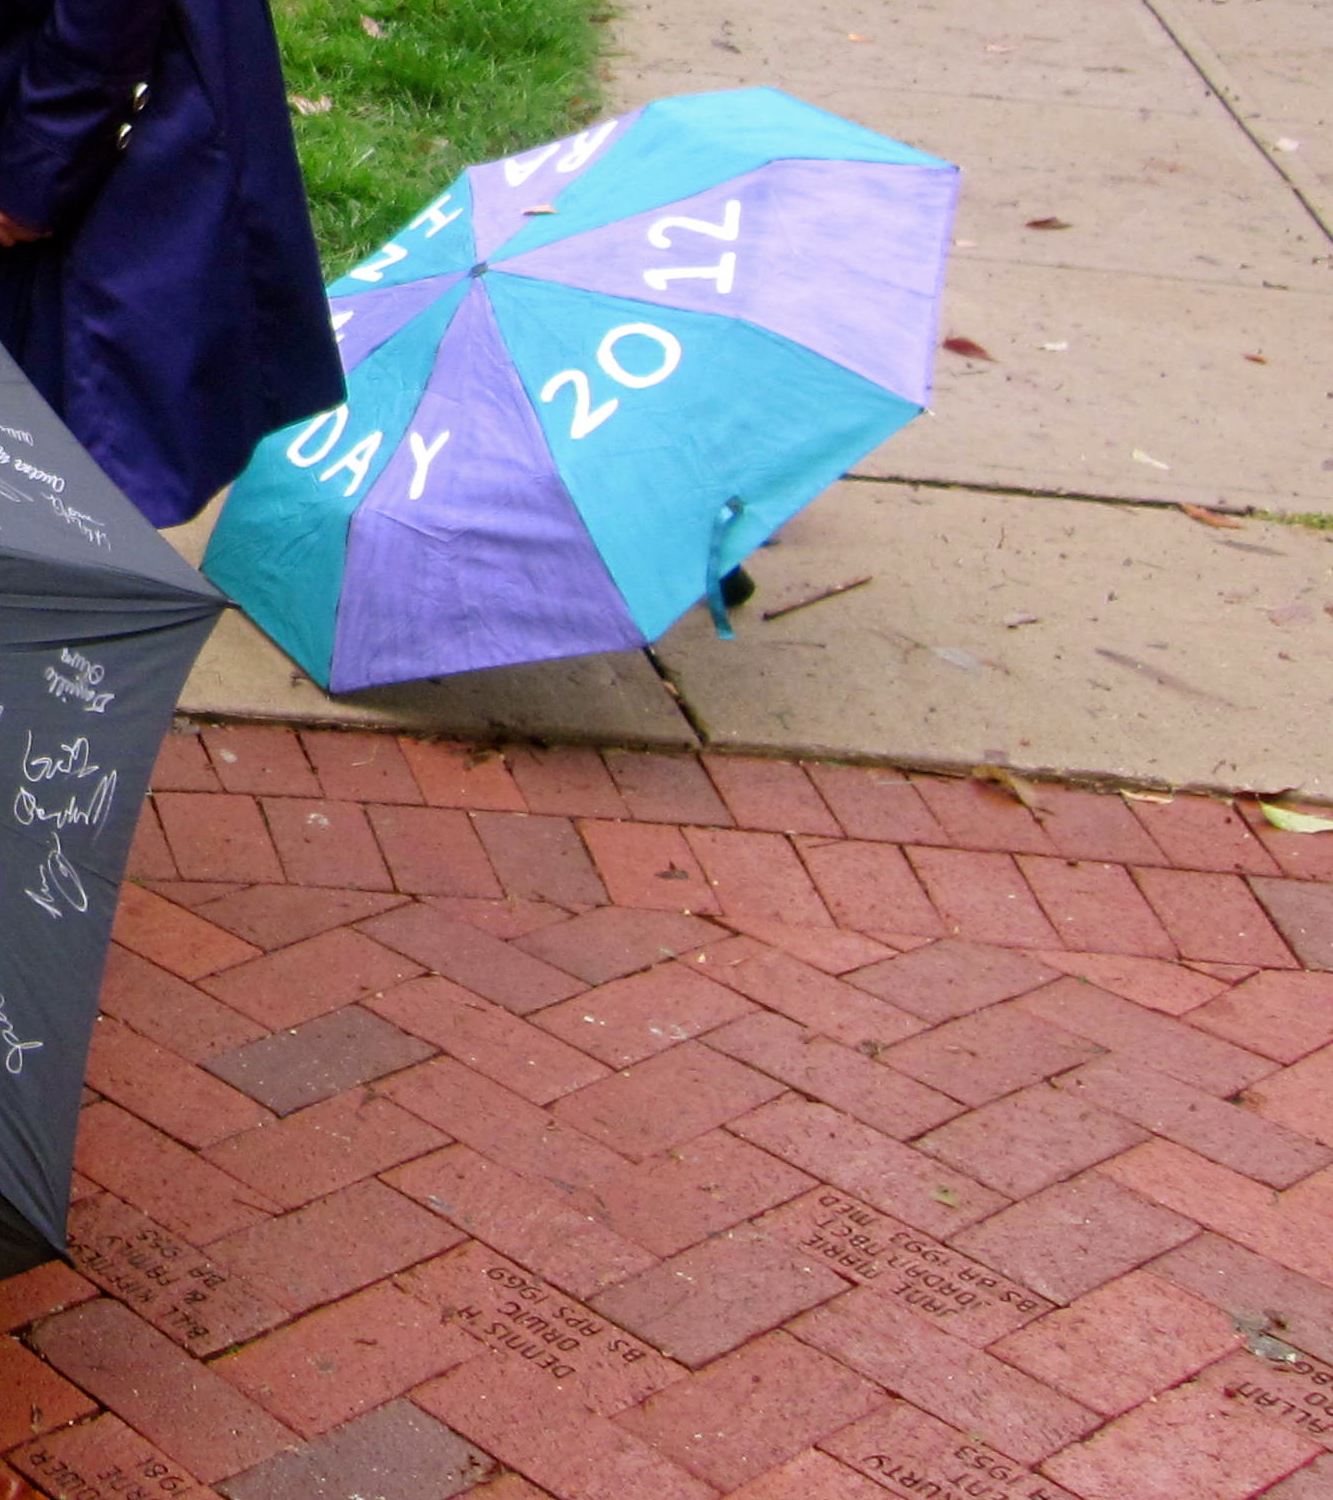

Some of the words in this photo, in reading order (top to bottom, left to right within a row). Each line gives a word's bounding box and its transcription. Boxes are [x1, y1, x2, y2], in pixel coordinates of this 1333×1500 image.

[816, 1194, 875, 1228] MED
[799, 1231, 880, 1280] MARIE
[887, 1230, 950, 1267] 1993
[484, 1265, 548, 1305] 1969
[885, 1254, 992, 1311] JORDAN
[891, 1281, 959, 1318] JANE
[997, 1288, 1039, 1314] BS
[551, 1304, 604, 1338] APS
[482, 1320, 576, 1381] DENNIS
[606, 1338, 648, 1364] BS
[951, 1443, 1021, 1486] 1953
